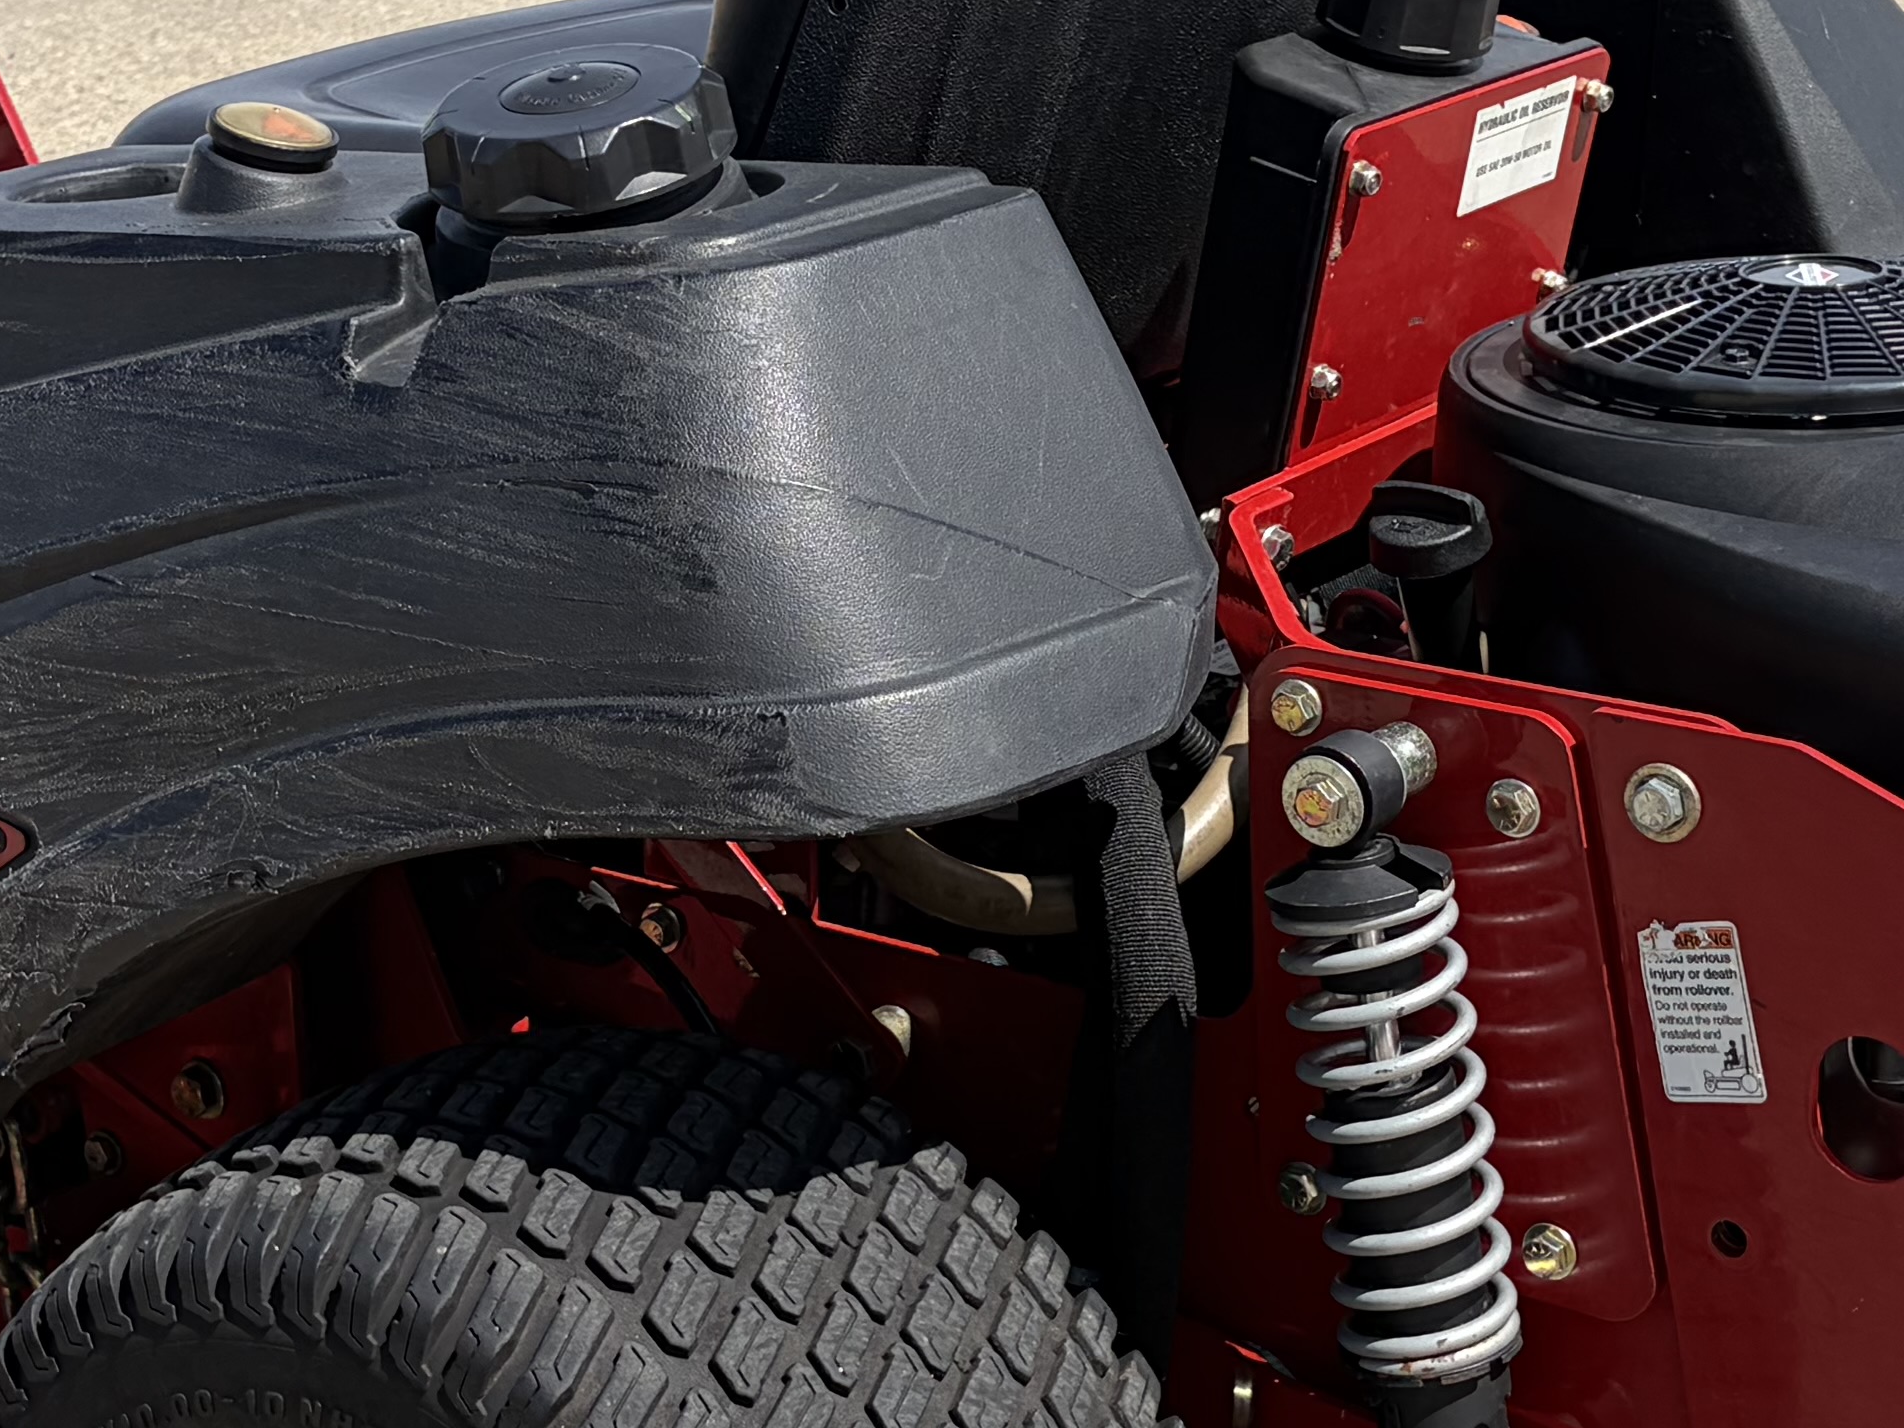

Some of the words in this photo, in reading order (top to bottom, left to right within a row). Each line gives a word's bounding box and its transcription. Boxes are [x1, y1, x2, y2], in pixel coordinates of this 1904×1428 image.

[1686, 953, 1731, 964] serious
[1650, 968, 1685, 982] injury
[1689, 970, 1700, 979] or
[1703, 969, 1738, 979] death
[1652, 984, 1682, 996] from
[1685, 984, 1734, 996] rollover.
[1655, 1000, 1671, 1011] Do
[1673, 1001, 1689, 1011] not
[1690, 1001, 1727, 1013] operate
[1658, 1015, 1694, 1025] without
[1695, 1015, 1710, 1025] the
[1660, 1029, 1701, 1040] installed
[1702, 1029, 1721, 1040] and
